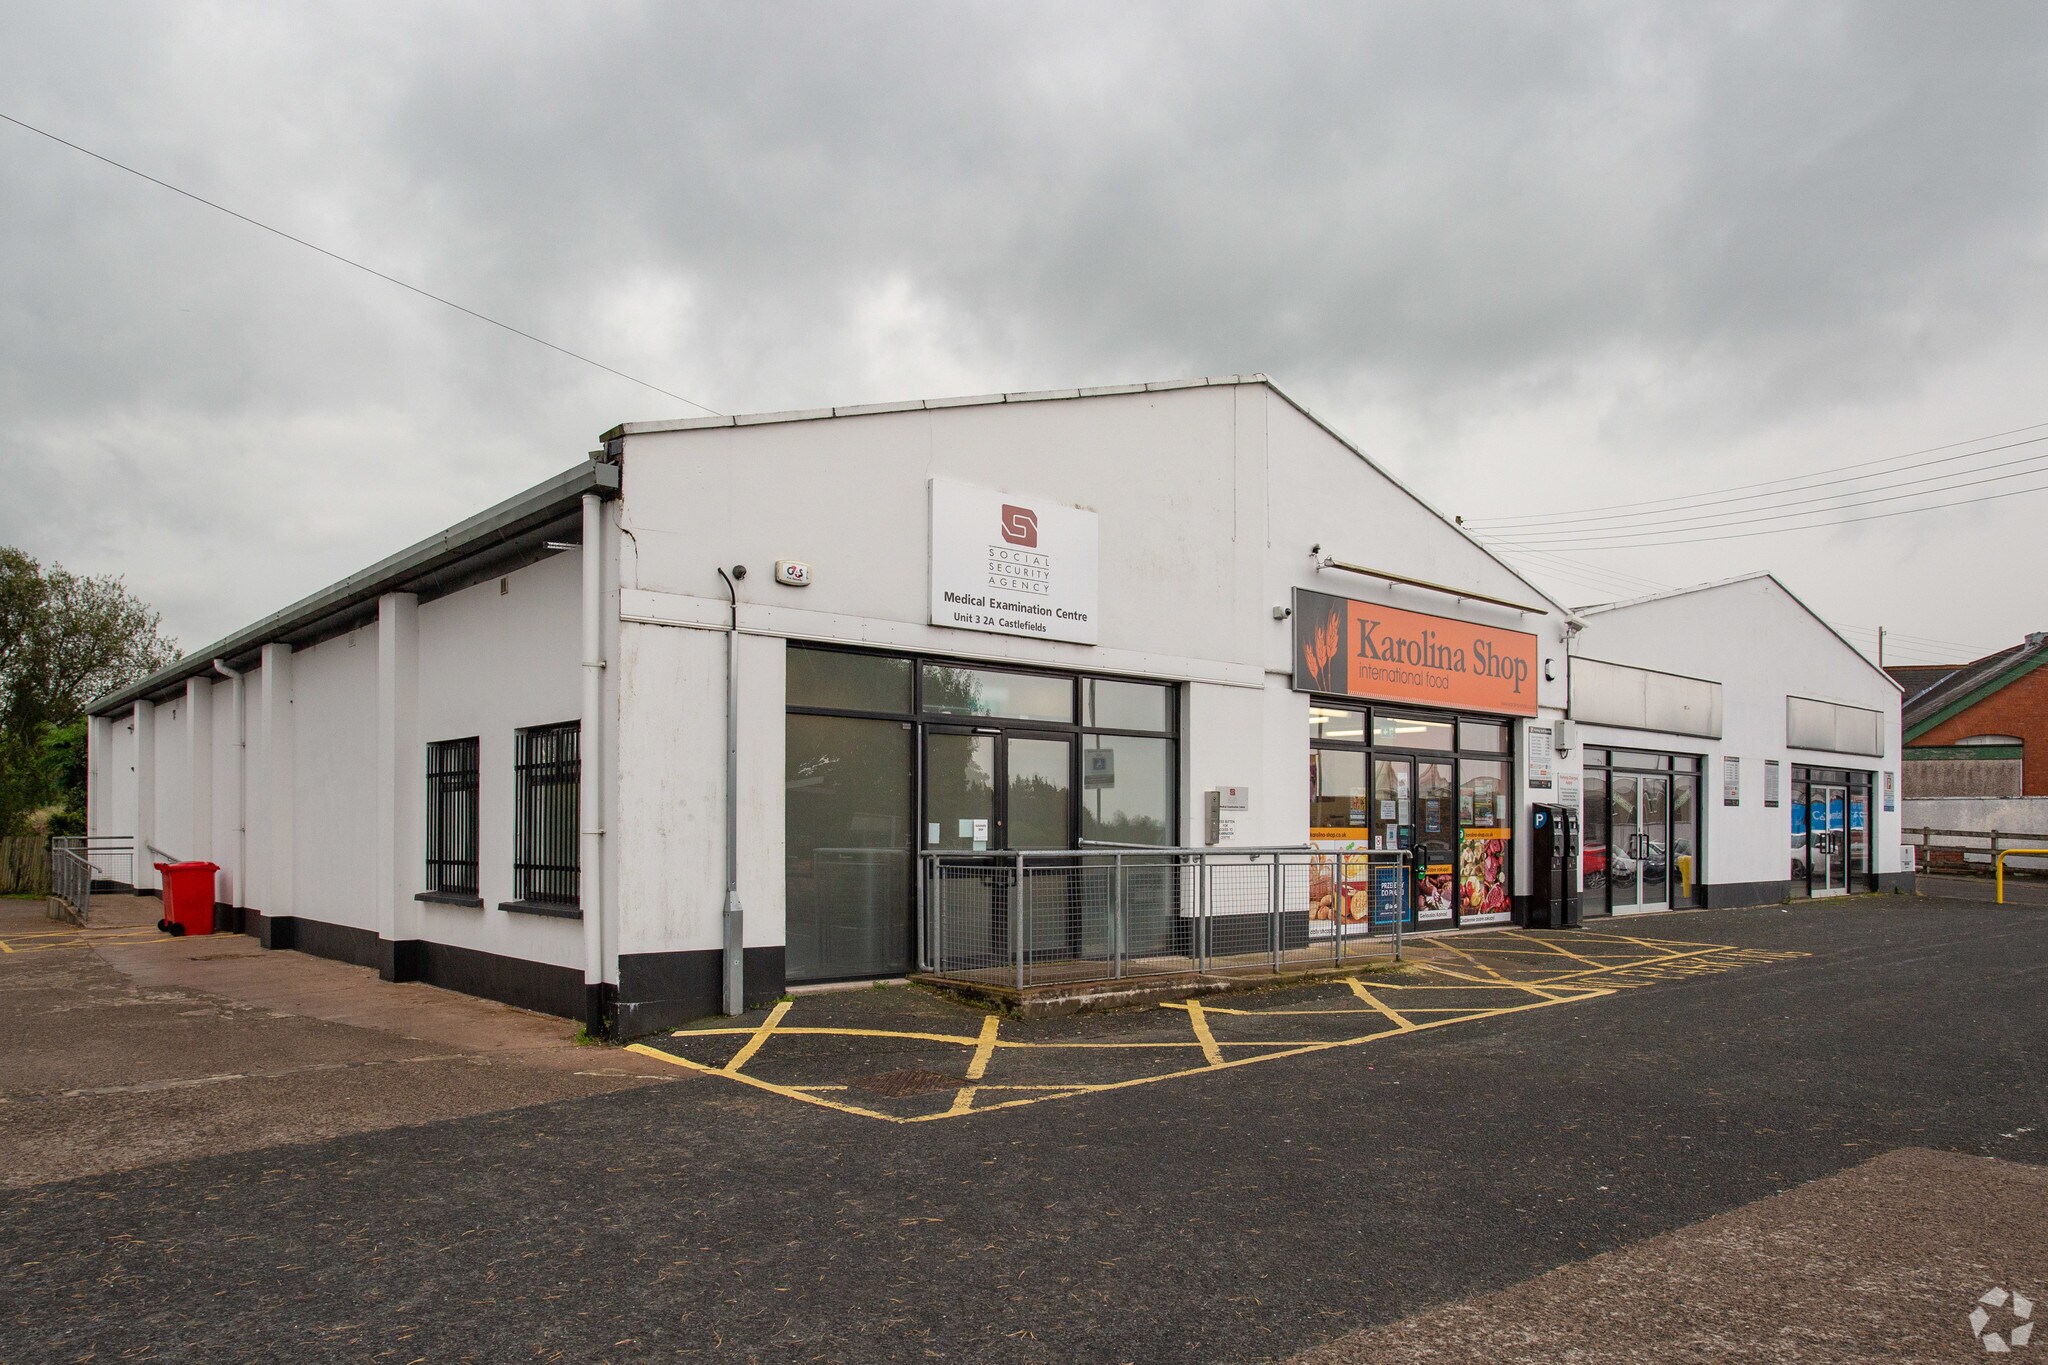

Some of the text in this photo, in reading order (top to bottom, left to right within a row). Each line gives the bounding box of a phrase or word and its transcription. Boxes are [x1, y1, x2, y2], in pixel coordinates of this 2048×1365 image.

[988, 548, 1050, 567] SOCIAL
[988, 562, 1050, 580] SECURITY
[988, 576, 1050, 593] AGENCY
[944, 591, 1088, 622] Medical Examination Centre
[953, 612, 1047, 633] Unit 3 2A Castlefields
[1357, 617, 1528, 694] Karolina Shop
[1359, 662, 1449, 690] international food
[1535, 813, 1544, 826] P
